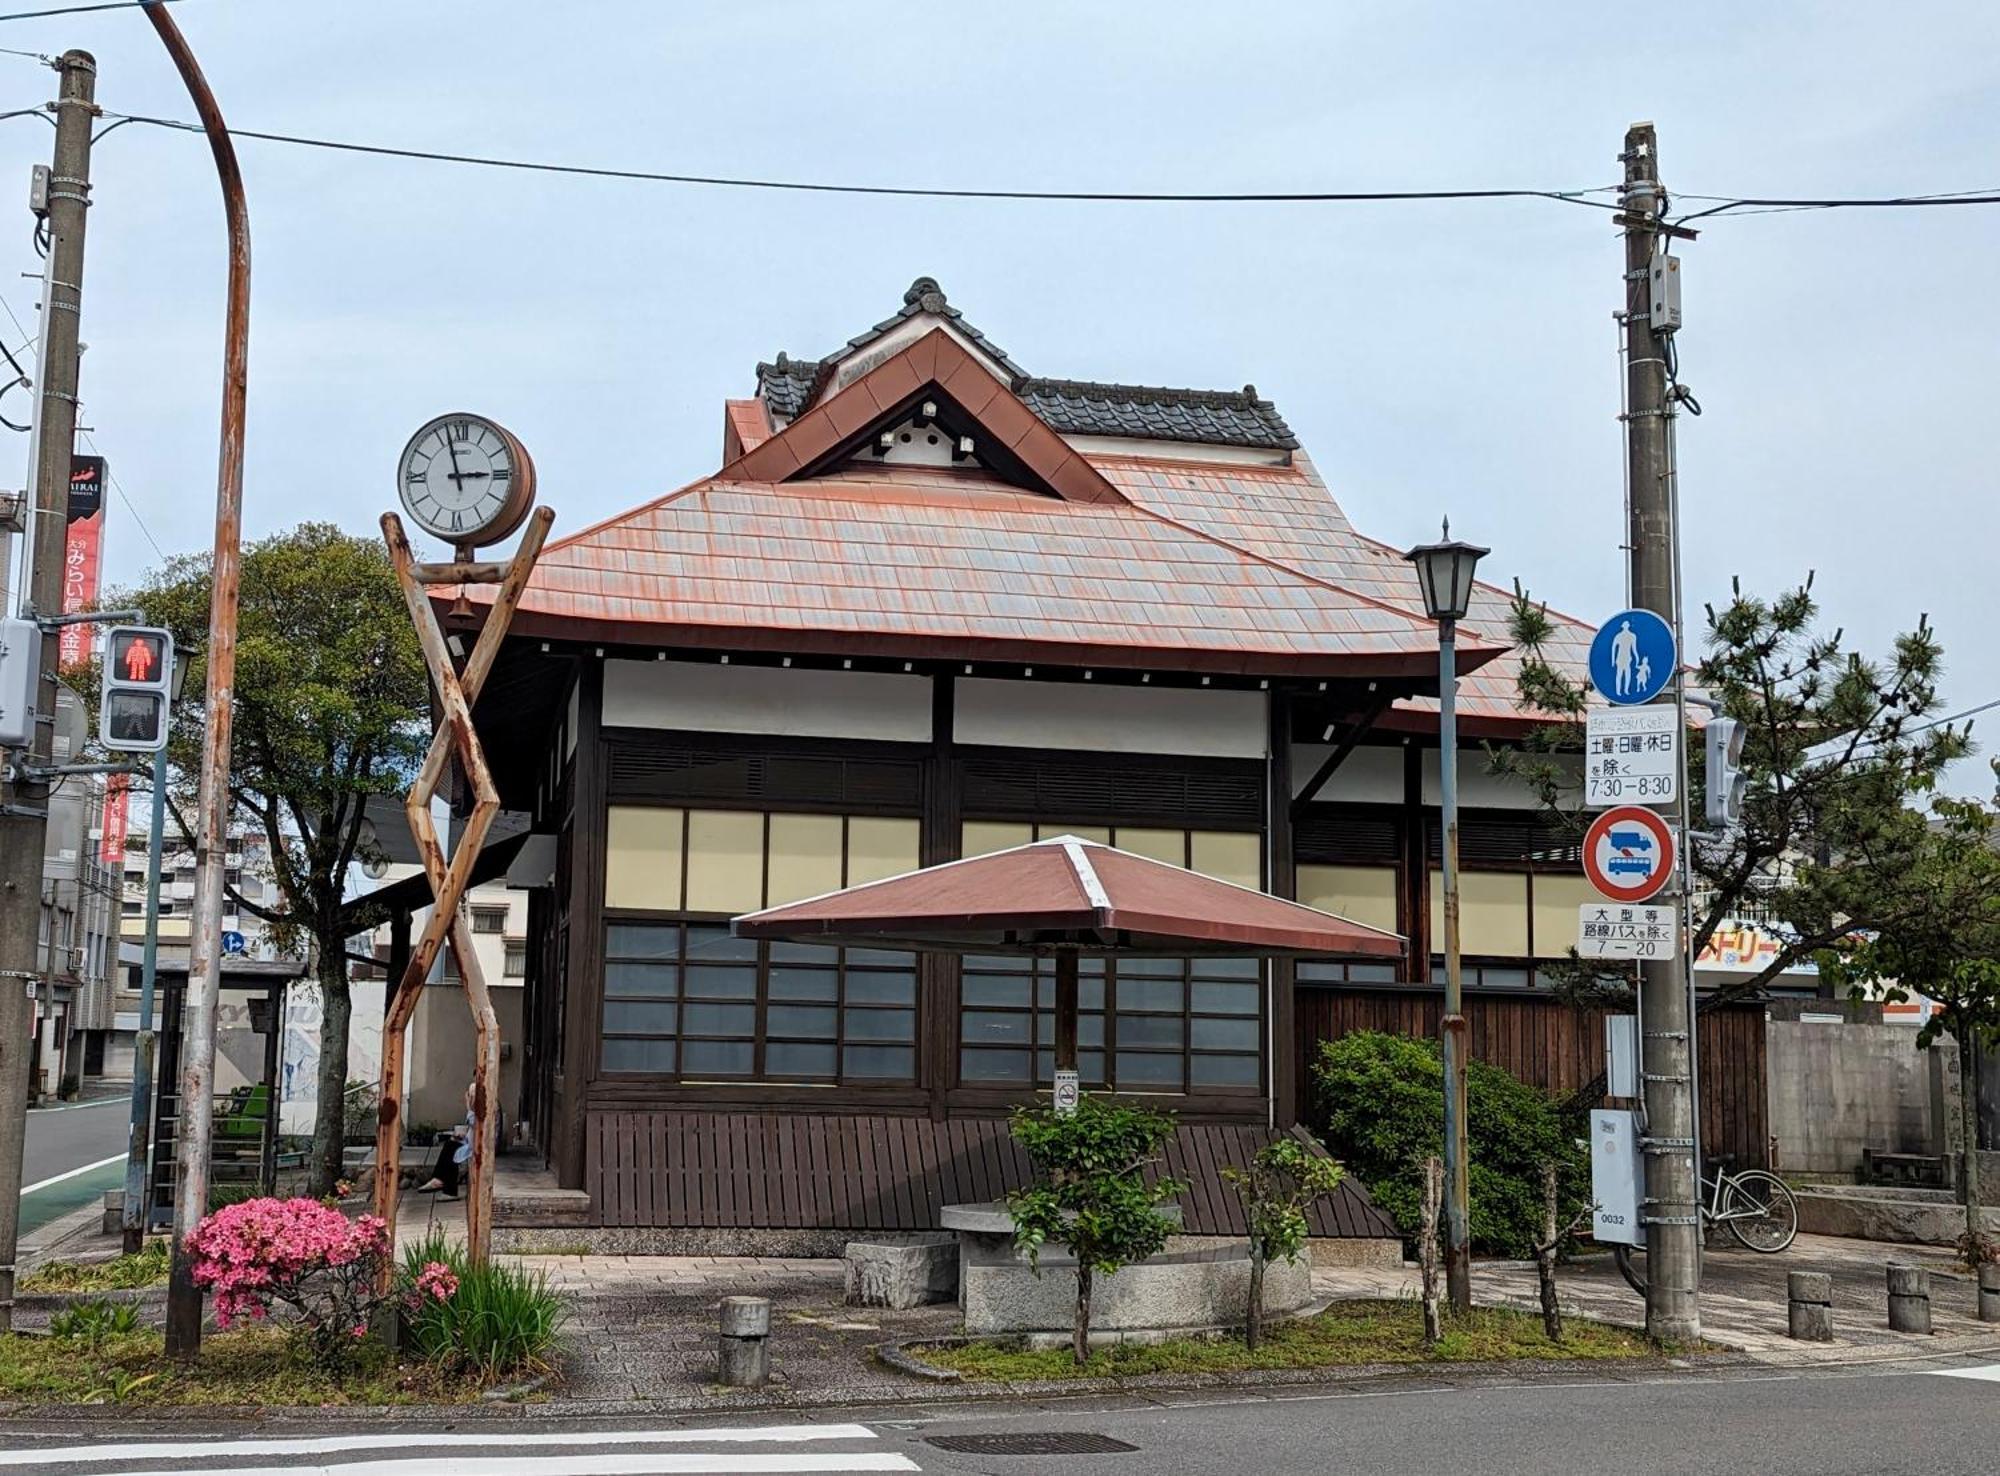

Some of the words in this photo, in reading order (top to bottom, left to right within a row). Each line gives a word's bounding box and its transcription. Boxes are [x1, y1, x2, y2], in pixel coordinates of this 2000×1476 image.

[1592, 759, 1631, 776] を除く
[1595, 908, 1658, 923] 大型等
[1584, 924, 1670, 939] 路線バスを除く
[1601, 1214, 1625, 1225] 0032
